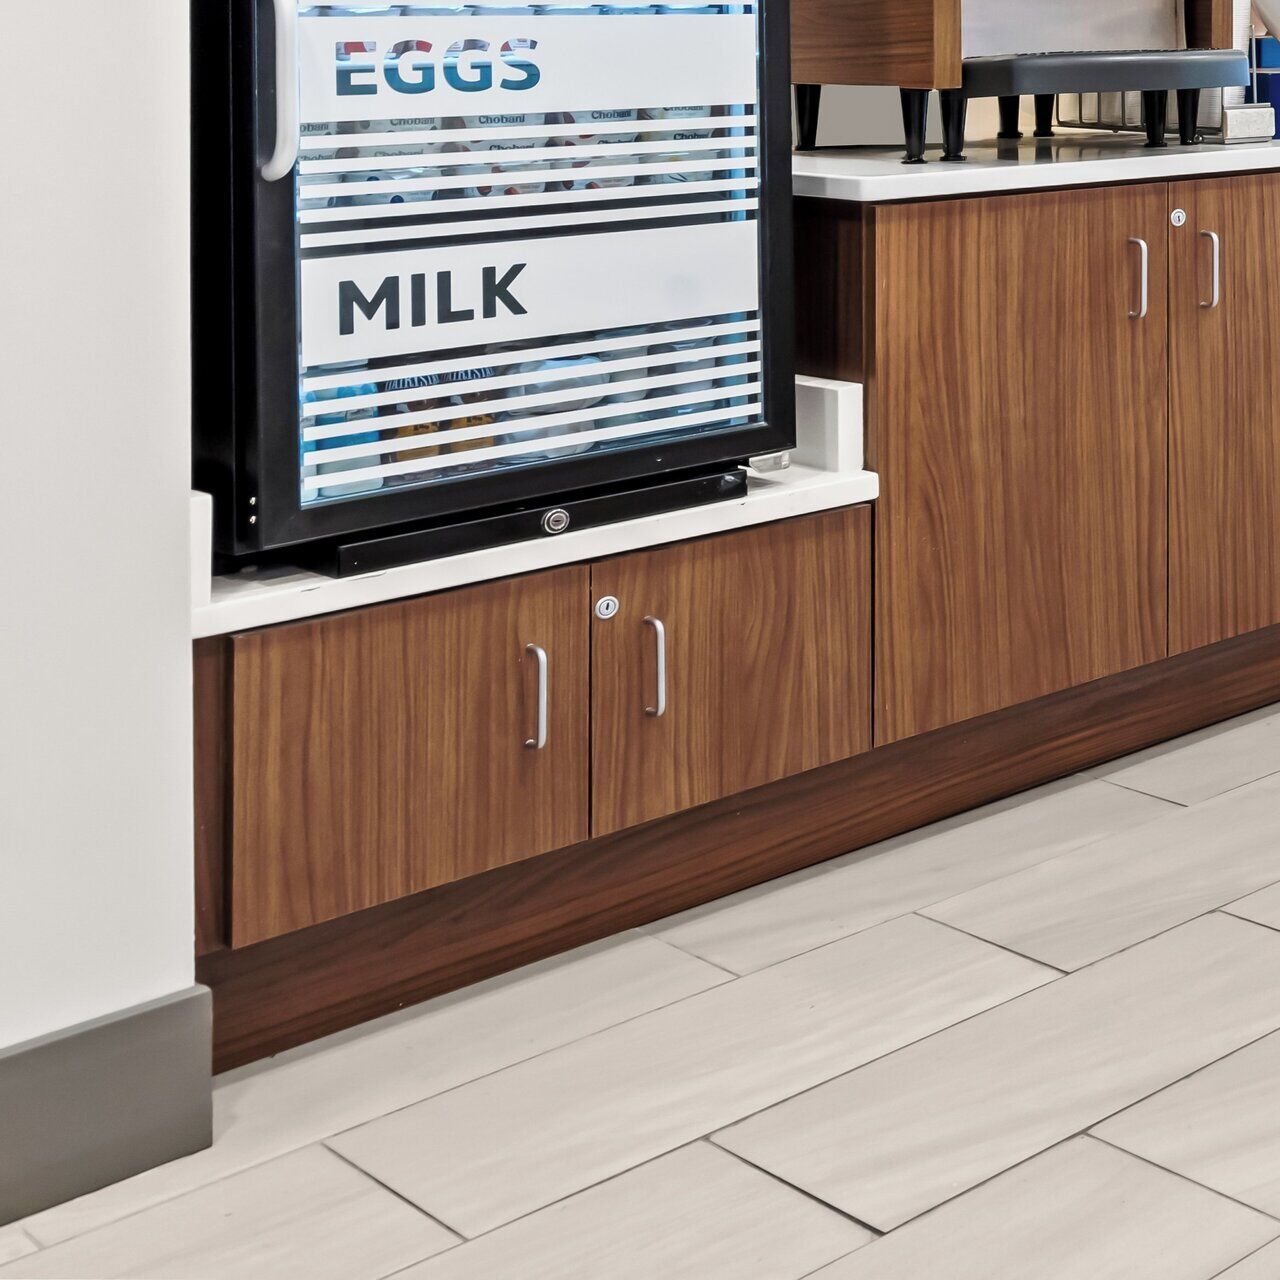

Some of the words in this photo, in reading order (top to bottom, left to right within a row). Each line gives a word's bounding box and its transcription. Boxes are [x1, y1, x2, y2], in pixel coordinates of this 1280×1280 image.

[335, 38, 541, 96] EGGS
[478, 114, 526, 124] Chobani
[338, 263, 528, 336] MILK
